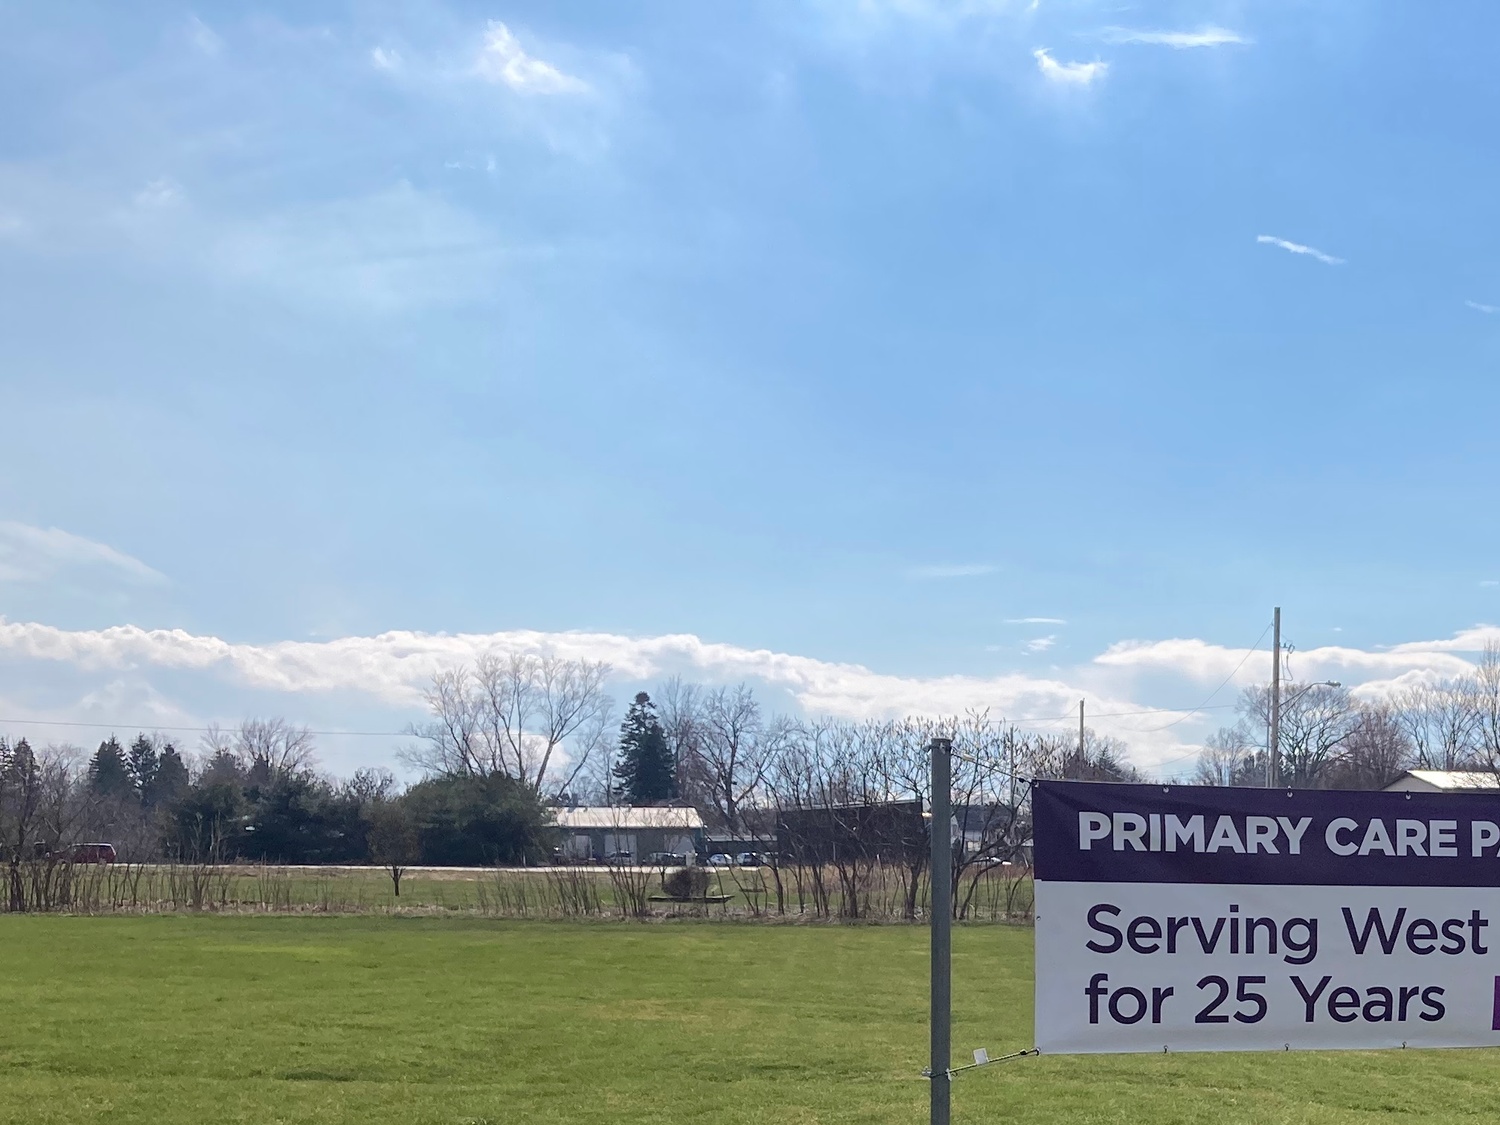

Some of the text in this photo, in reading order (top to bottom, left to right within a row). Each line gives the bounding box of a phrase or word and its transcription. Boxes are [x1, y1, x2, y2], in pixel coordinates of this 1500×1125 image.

[1078, 811, 1313, 855] PRIMARY
[1324, 817, 1458, 857] CARE
[1085, 903, 1319, 965] Serving
[1340, 906, 1489, 956] West
[1084, 972, 1446, 1025] for 25 Years
